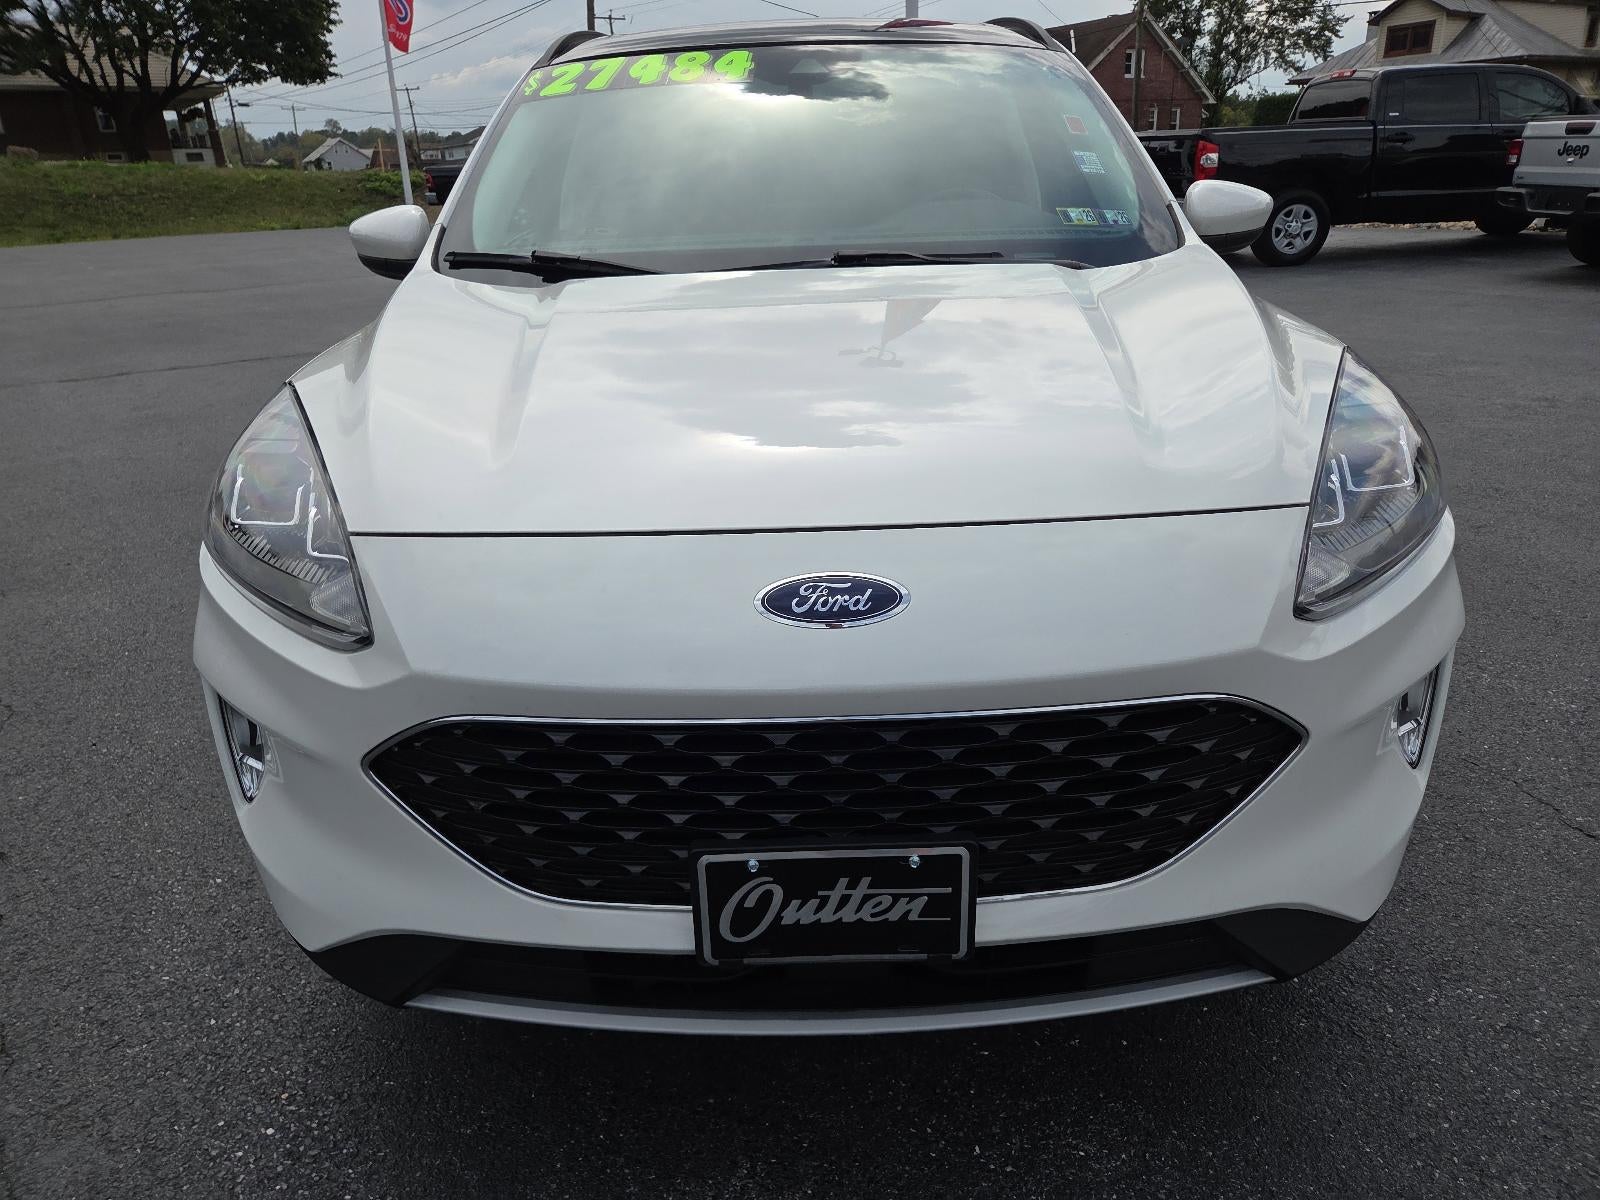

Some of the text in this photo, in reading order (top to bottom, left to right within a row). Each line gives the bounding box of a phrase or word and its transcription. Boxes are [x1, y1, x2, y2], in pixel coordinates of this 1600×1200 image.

[524, 50, 754, 97] $27484
[1557, 141, 1590, 159] Jeep
[791, 582, 873, 614] Ford
[719, 876, 952, 943] Outten
